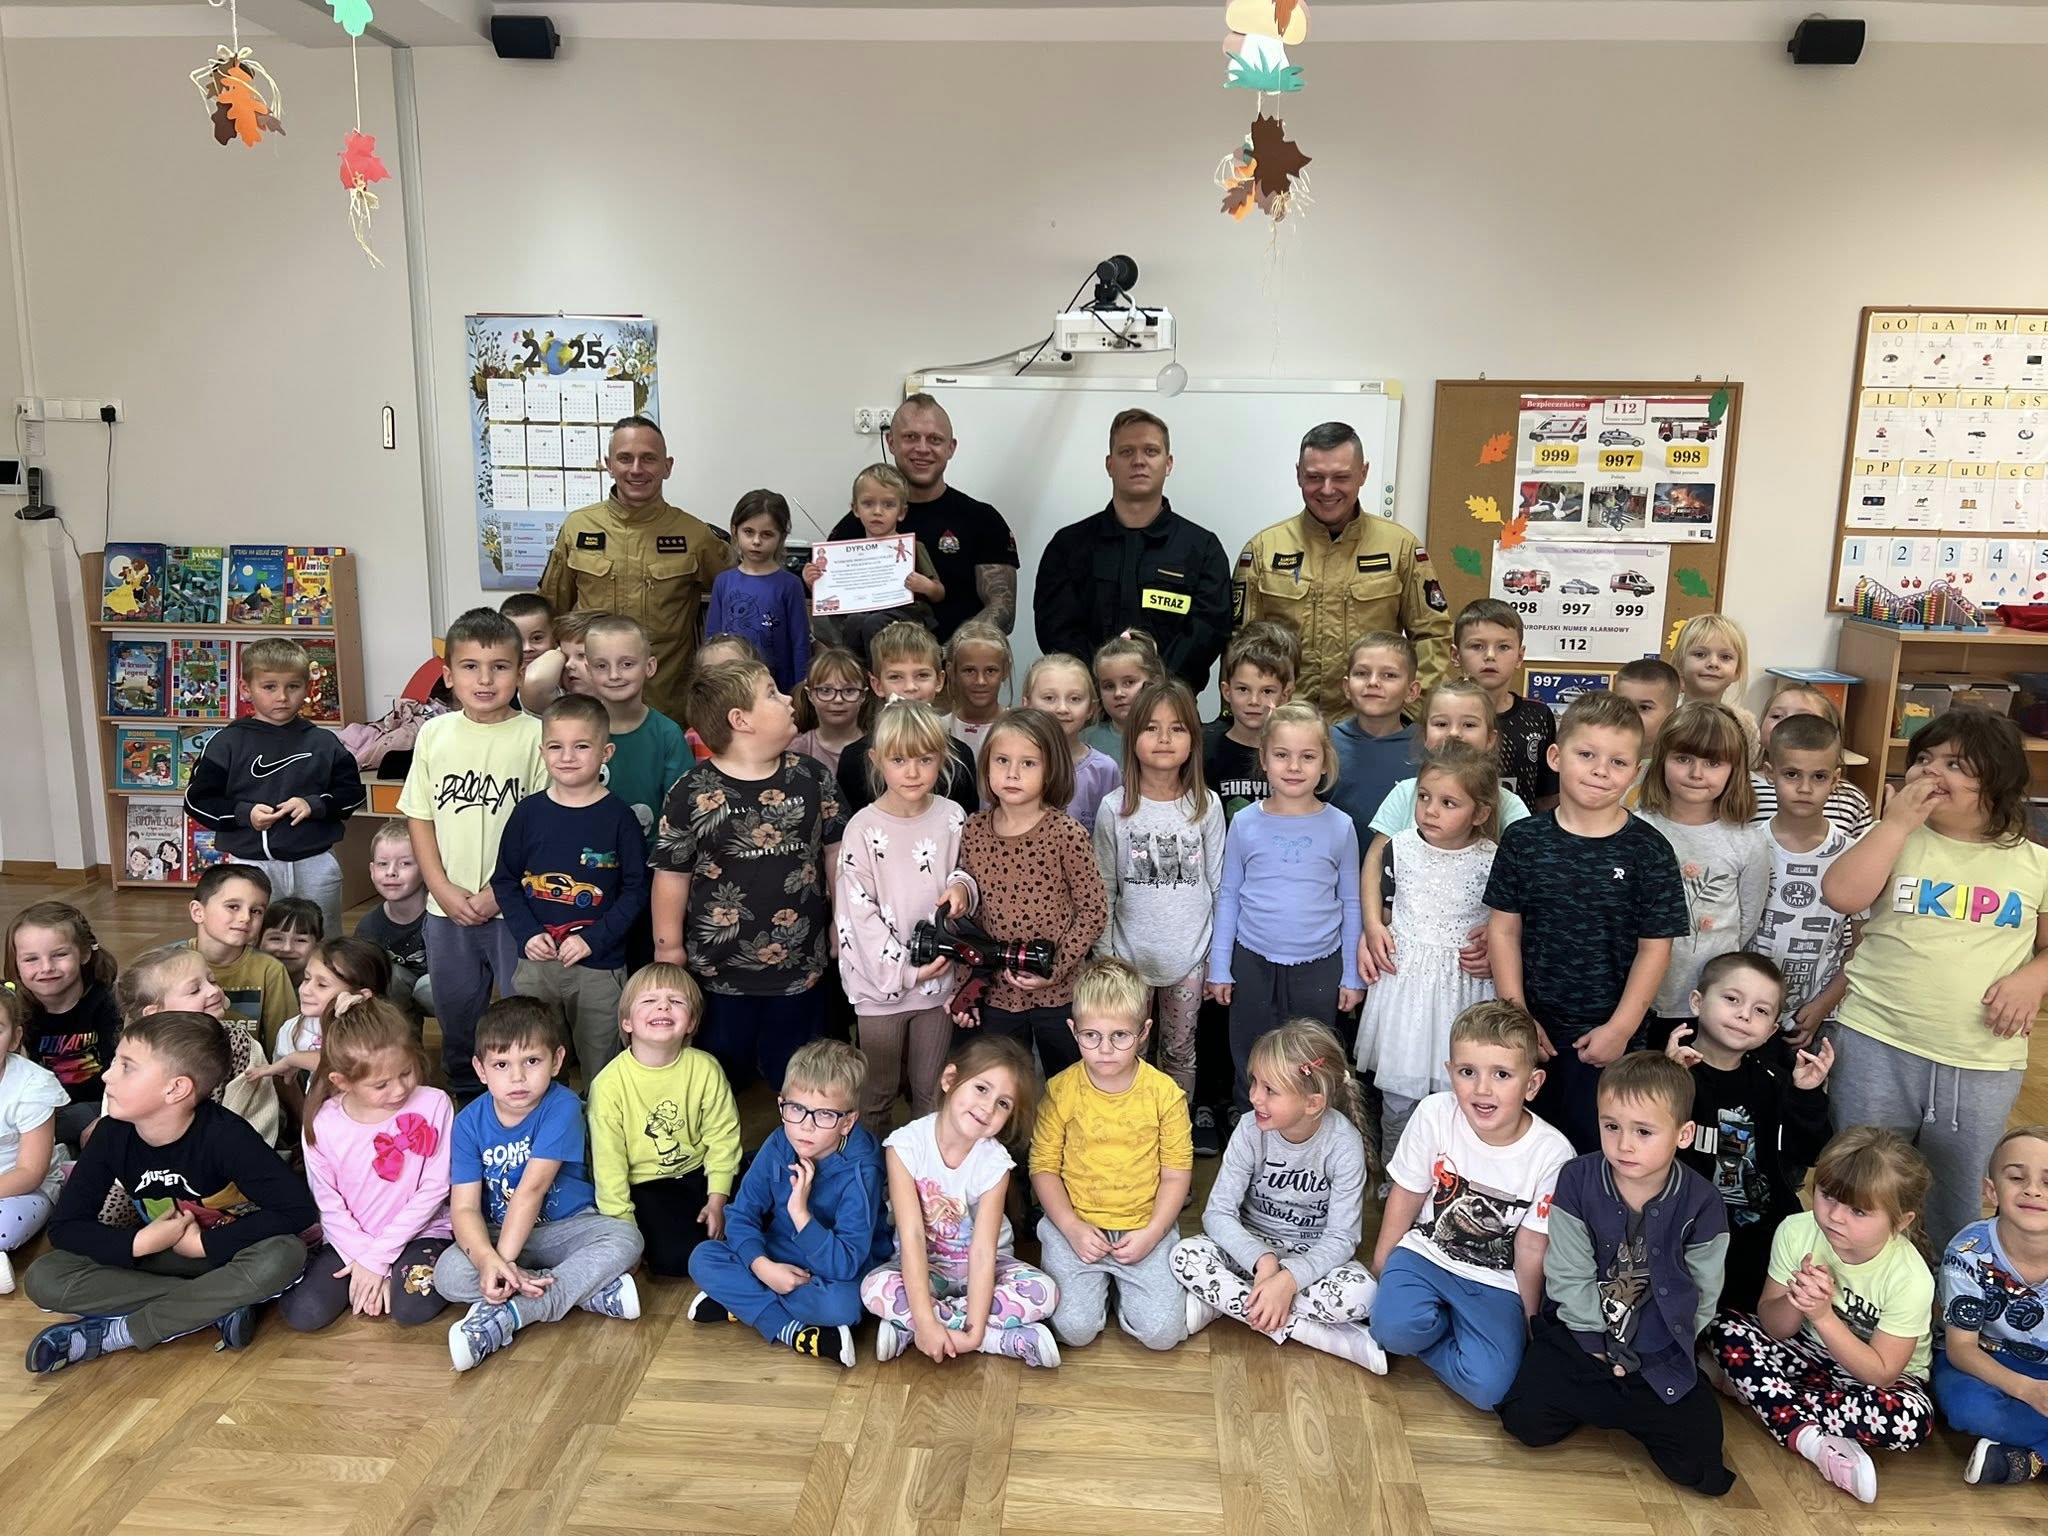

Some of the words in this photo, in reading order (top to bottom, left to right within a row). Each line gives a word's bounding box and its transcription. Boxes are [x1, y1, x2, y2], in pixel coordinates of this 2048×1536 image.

[1882, 321, 1890, 330] o
[1897, 318, 1908, 330] O
[1931, 321, 1939, 330] a
[1945, 319, 1955, 330] A
[1975, 321, 1988, 330] m
[1994, 319, 2008, 331] M
[2028, 323, 2036, 332] e
[1527, 400, 1586, 410] Bezpieczeństwo
[1876, 393, 1880, 405] l
[1888, 394, 1897, 405] L
[1921, 395, 1930, 407] y
[1937, 393, 1947, 404] Y
[1971, 397, 1978, 406] r
[1984, 395, 1993, 407] R
[2020, 398, 2026, 406] s
[2033, 395, 2041, 407] S
[1613, 402, 1637, 414] 112
[1541, 449, 1570, 462] 999
[1605, 454, 1635, 468] 997
[1673, 450, 1701, 463] 998
[1866, 463, 1874, 475] p
[1881, 461, 1890, 473] P
[1914, 465, 1921, 474] z
[1927, 463, 1937, 475] Z
[1961, 467, 1969, 476] u
[1976, 465, 1987, 477] U
[2010, 468, 2017, 477] c
[2024, 465, 2034, 477] C
[845, 543, 878, 553] DYPLOM
[1852, 545, 1858, 560] 1
[1897, 546, 1908, 561] 2
[1944, 547, 1955, 562] 3
[1993, 548, 2003, 563] 4
[2040, 549, 2048, 563] 5
[1562, 603, 1591, 615] 997
[1615, 604, 1644, 617] 999
[1523, 624, 1561, 632] UROPEJSKI
[1560, 638, 1587, 650] 112
[1533, 675, 1561, 687] 997
[1220, 780, 1268, 797] SURVI
[1785, 893, 1812, 906] ANVIL
[1893, 876, 2023, 929] EKIPA
[38, 1031, 99, 1055] PIKACHU
